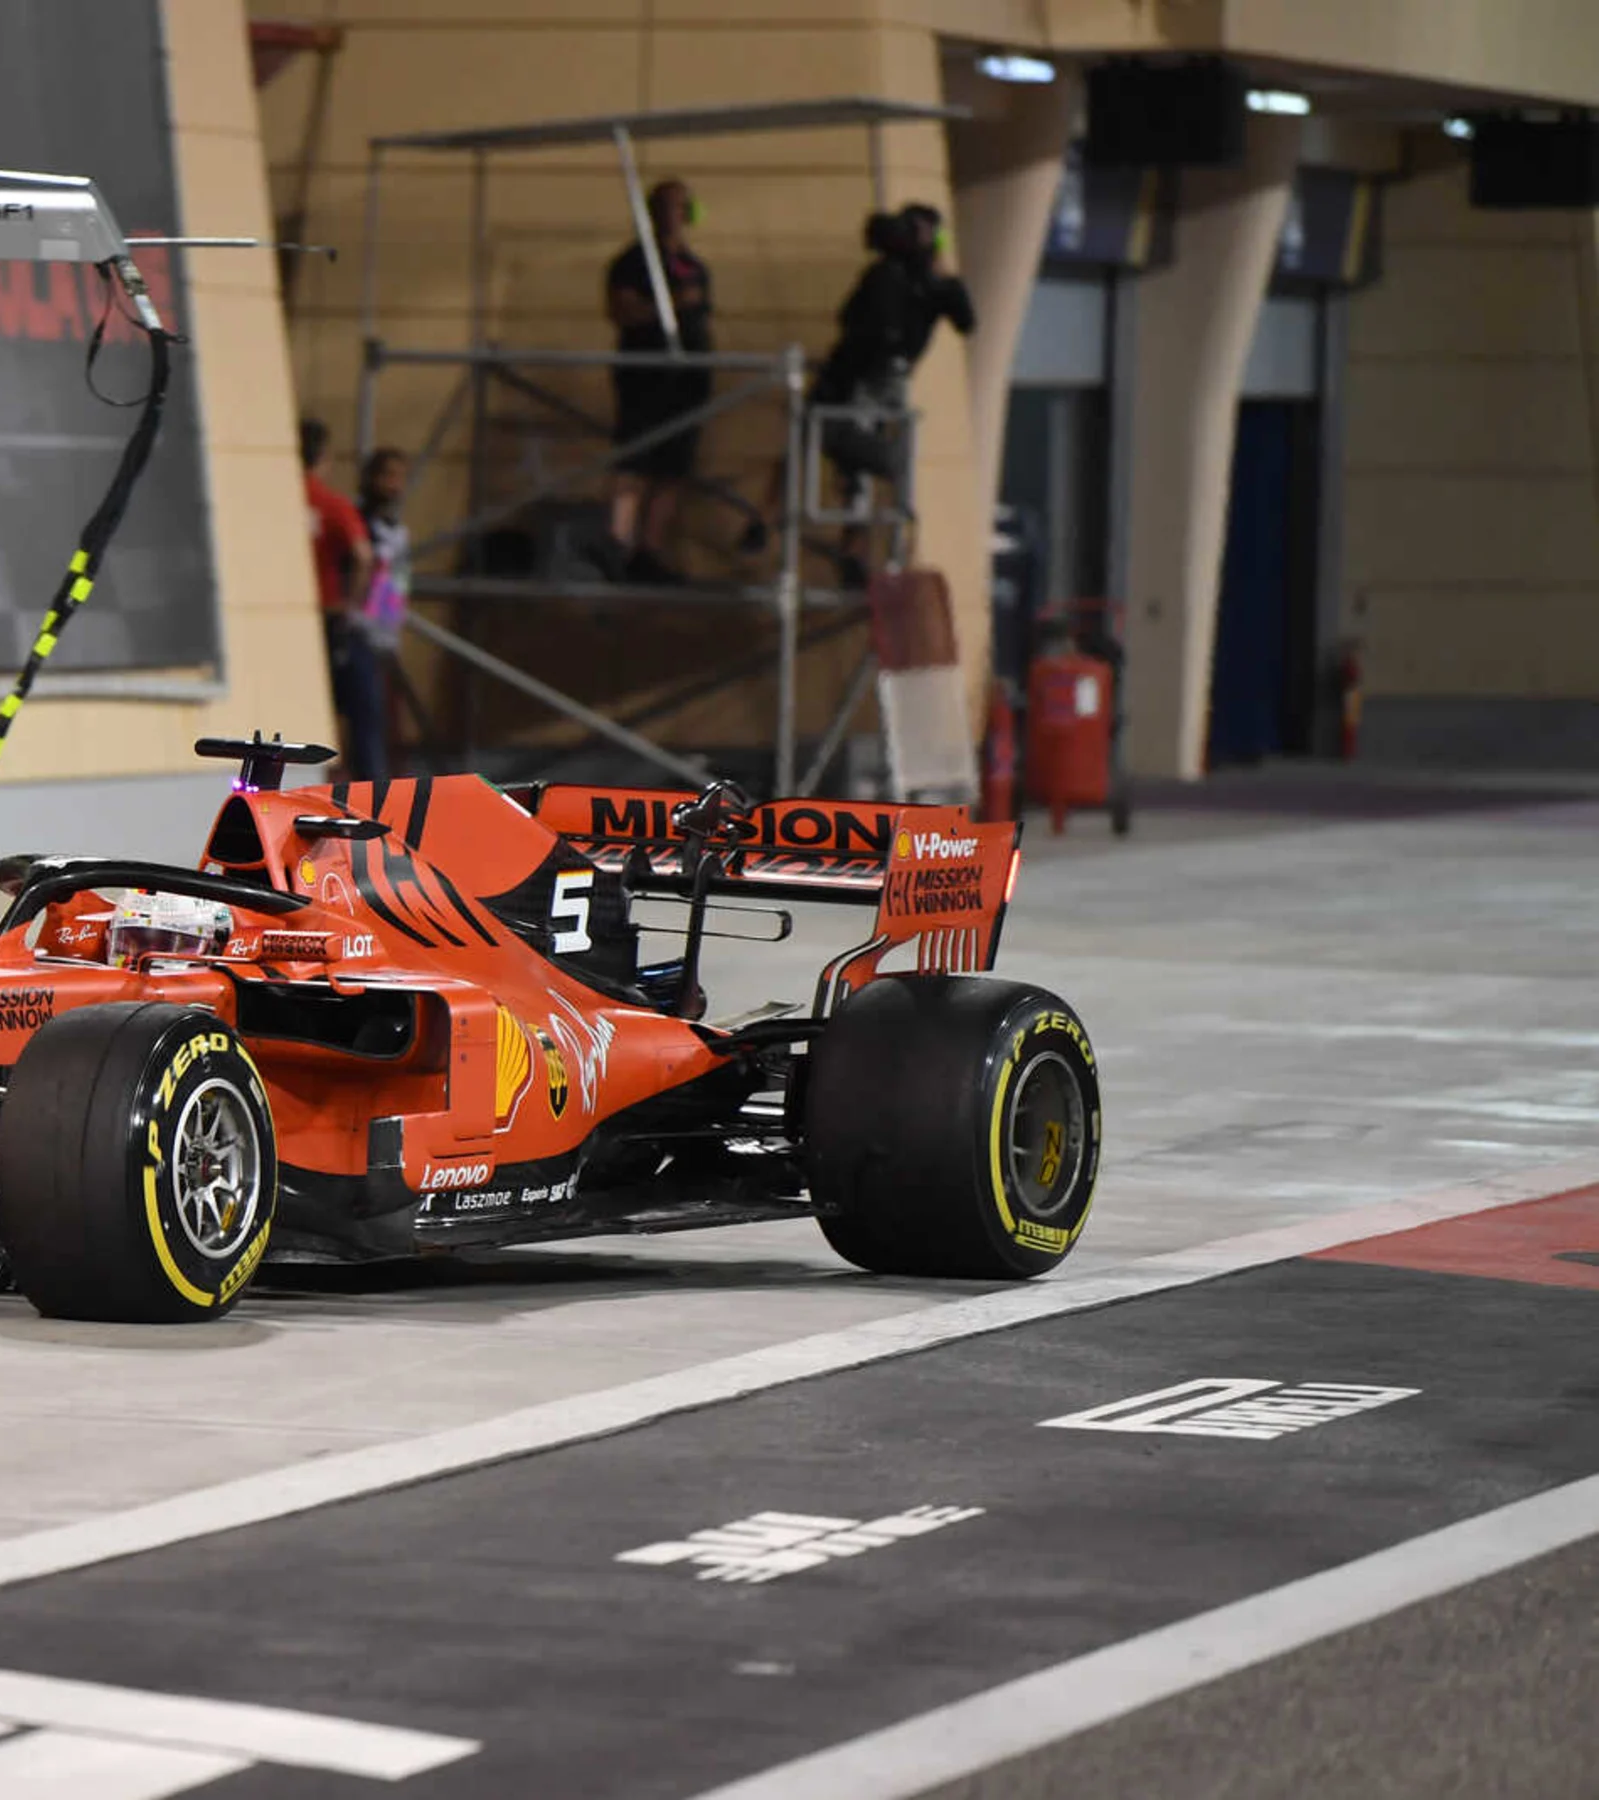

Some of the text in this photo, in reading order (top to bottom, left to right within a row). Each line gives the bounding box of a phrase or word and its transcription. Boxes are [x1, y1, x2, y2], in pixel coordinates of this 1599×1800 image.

[913, 832, 979, 860] V-Power
[914, 864, 983, 892] MISSION
[550, 869, 595, 954] 5
[914, 889, 983, 914] WINNOW
[1033, 1010, 1094, 1066] ZERO
[155, 1032, 229, 1111] ZERO
[420, 1164, 489, 1189] Lenovo
